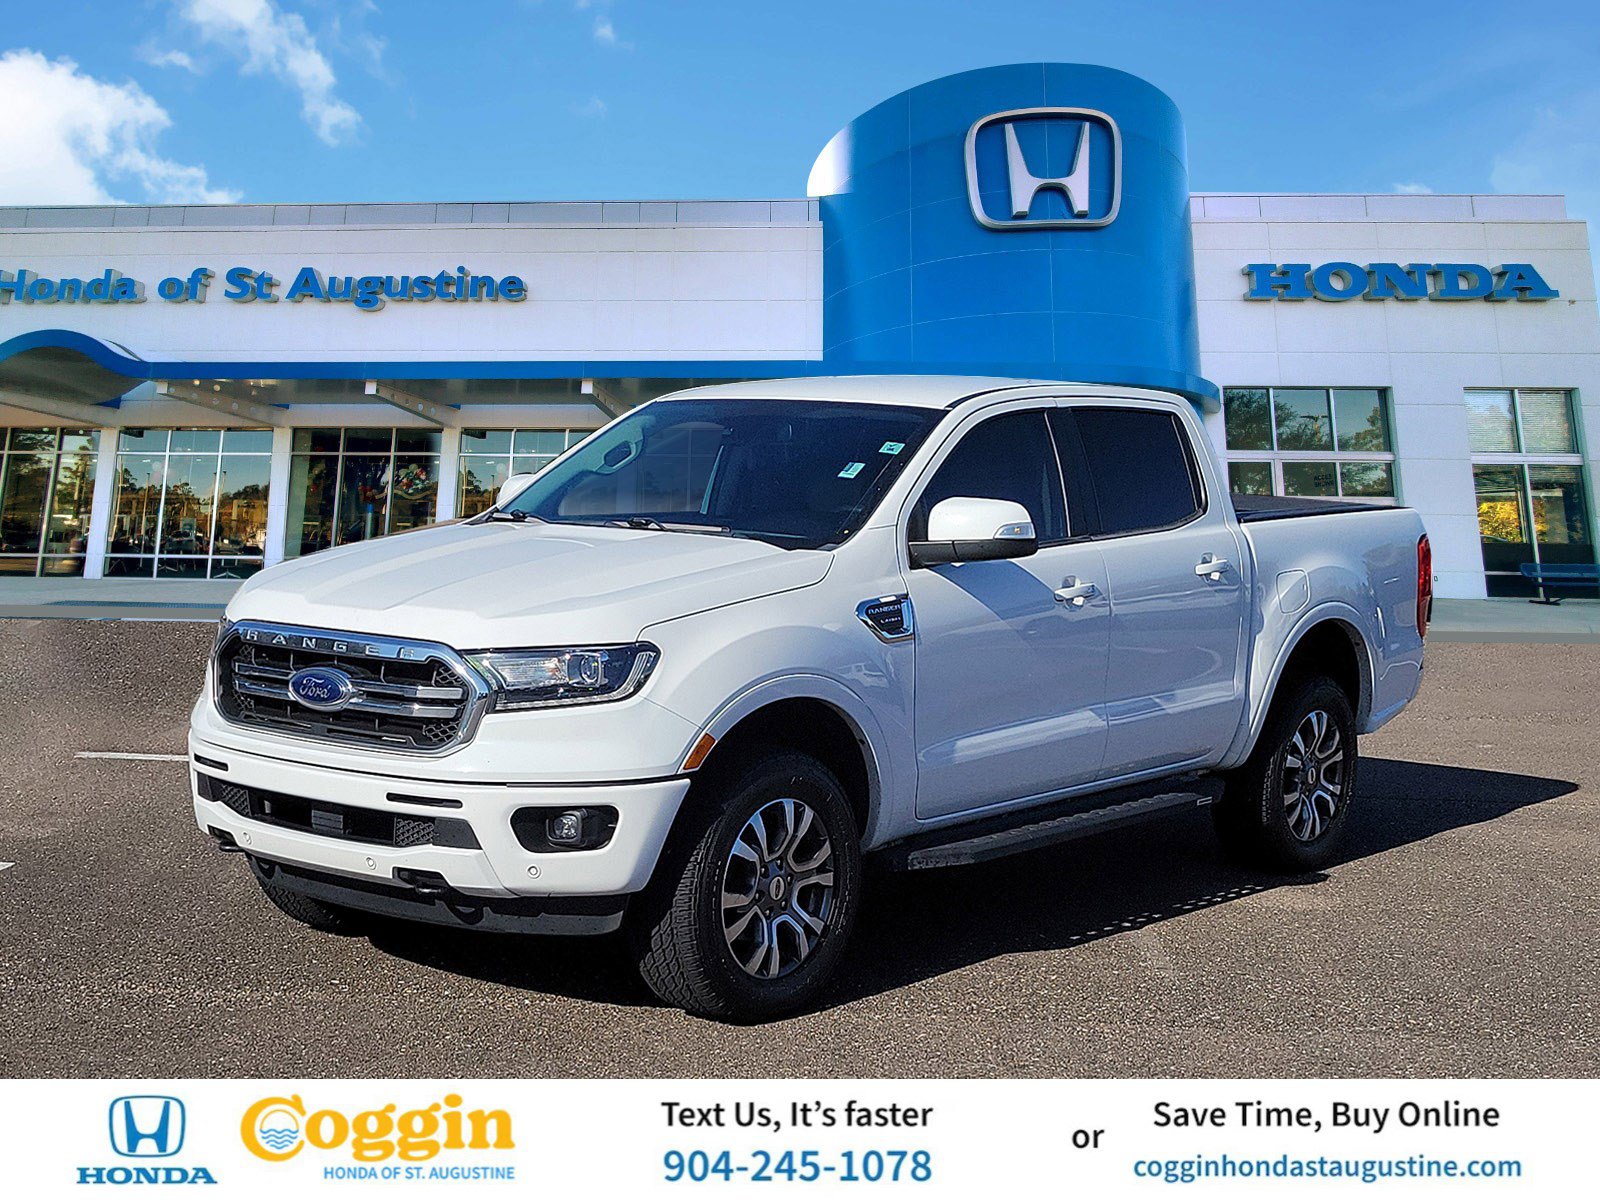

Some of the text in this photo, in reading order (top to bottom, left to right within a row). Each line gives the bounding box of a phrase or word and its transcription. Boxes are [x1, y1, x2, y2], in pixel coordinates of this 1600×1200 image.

[158, 267, 215, 304] of
[224, 266, 281, 303] St
[286, 265, 528, 312] Augustine
[1242, 262, 1560, 302] HONDA
[868, 604, 902, 615] RANGER
[245, 629, 414, 659] RANGER
[299, 676, 332, 699] Ford
